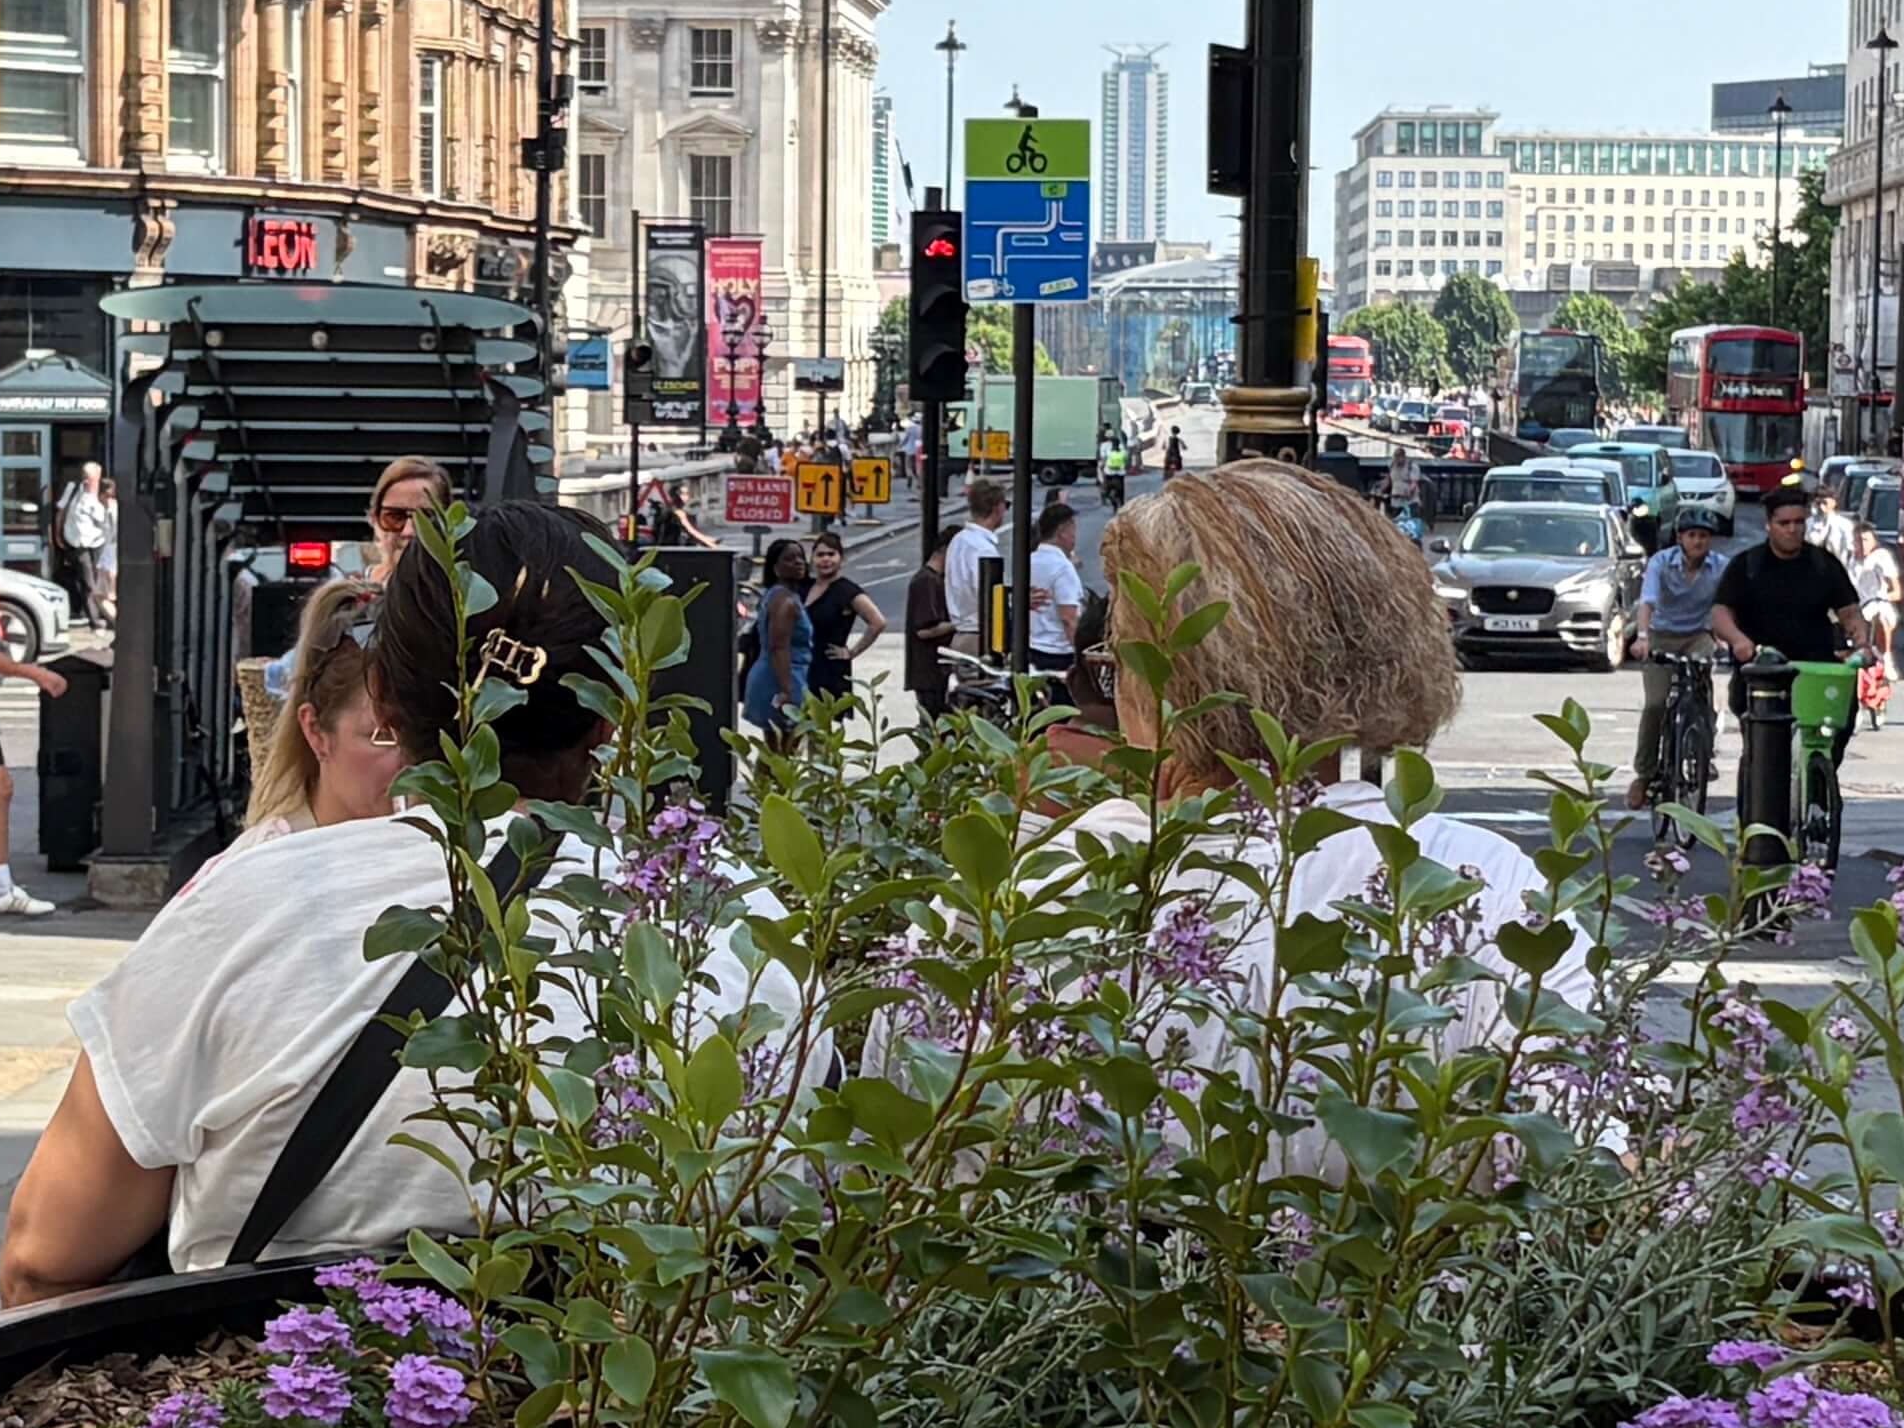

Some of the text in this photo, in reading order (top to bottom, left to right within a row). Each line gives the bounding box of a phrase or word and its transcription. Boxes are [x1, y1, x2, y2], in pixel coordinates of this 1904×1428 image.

[248, 218, 319, 269] LEON
[711, 278, 759, 295] HOLY
[727, 480, 790, 493] BUS LANE
[736, 494, 779, 507] AHEAD
[732, 508, 784, 520] CLOSED
